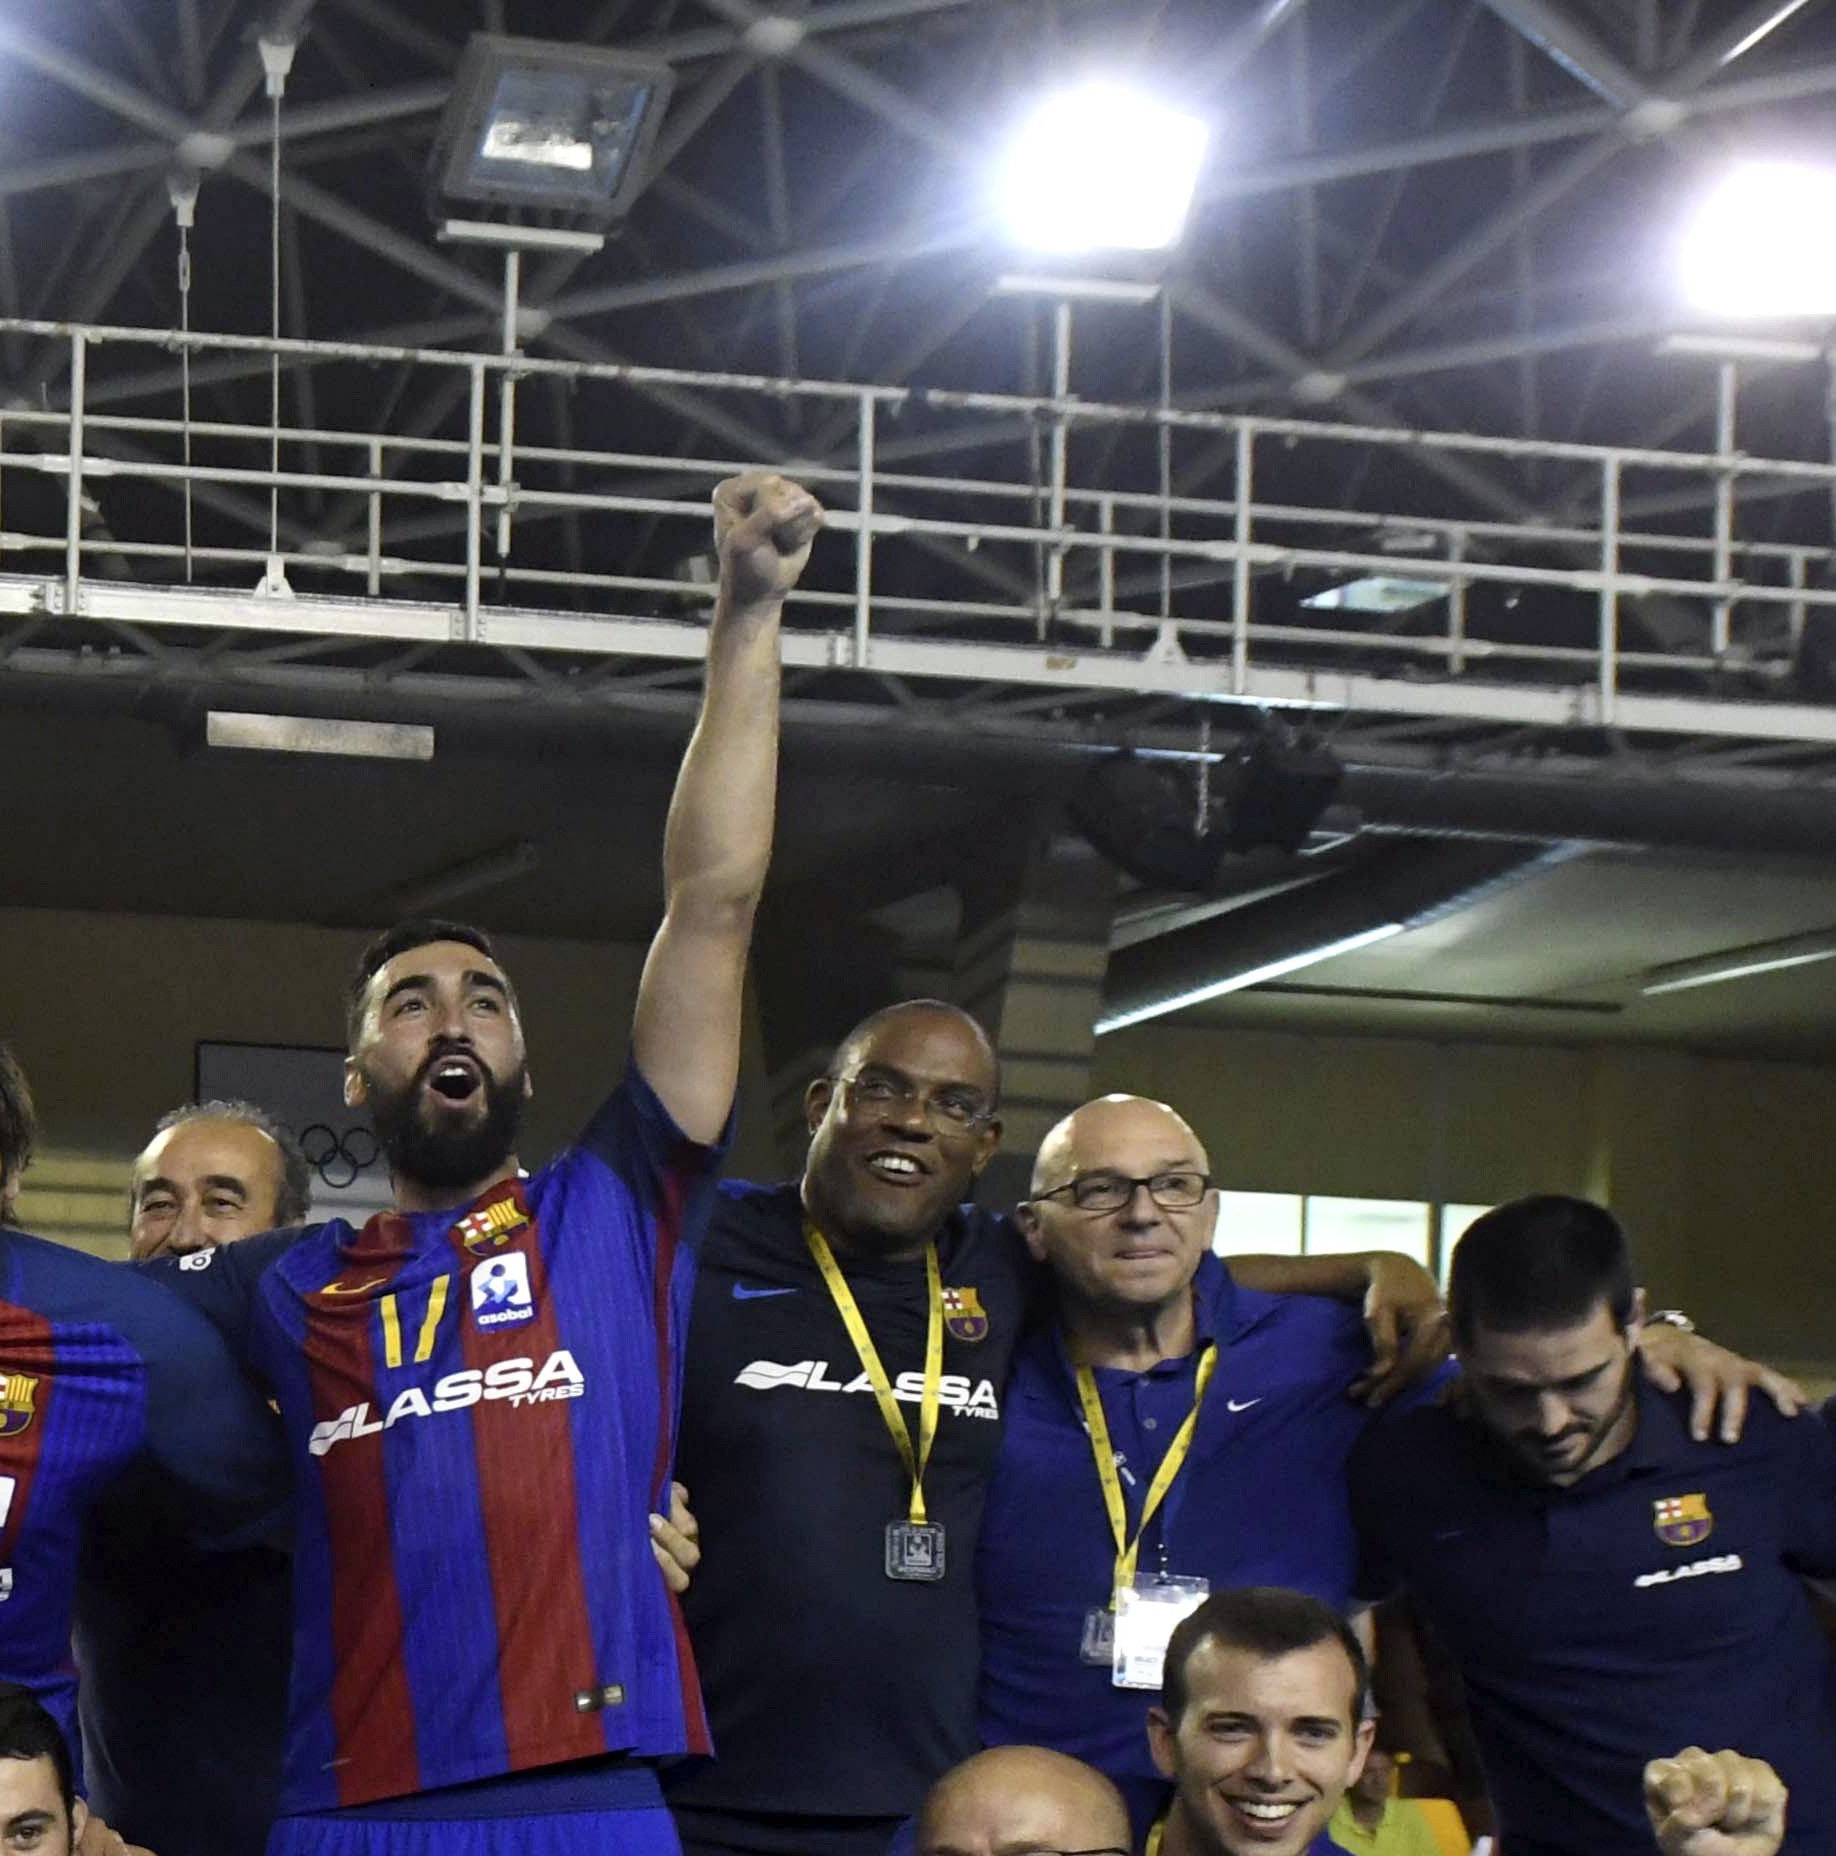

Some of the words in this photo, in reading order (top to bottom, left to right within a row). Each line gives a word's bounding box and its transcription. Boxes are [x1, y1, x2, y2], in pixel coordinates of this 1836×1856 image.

[477, 1306, 533, 1326] asobal
[350, 1350, 585, 1439] LASSA
[509, 1383, 585, 1408] TYRES
